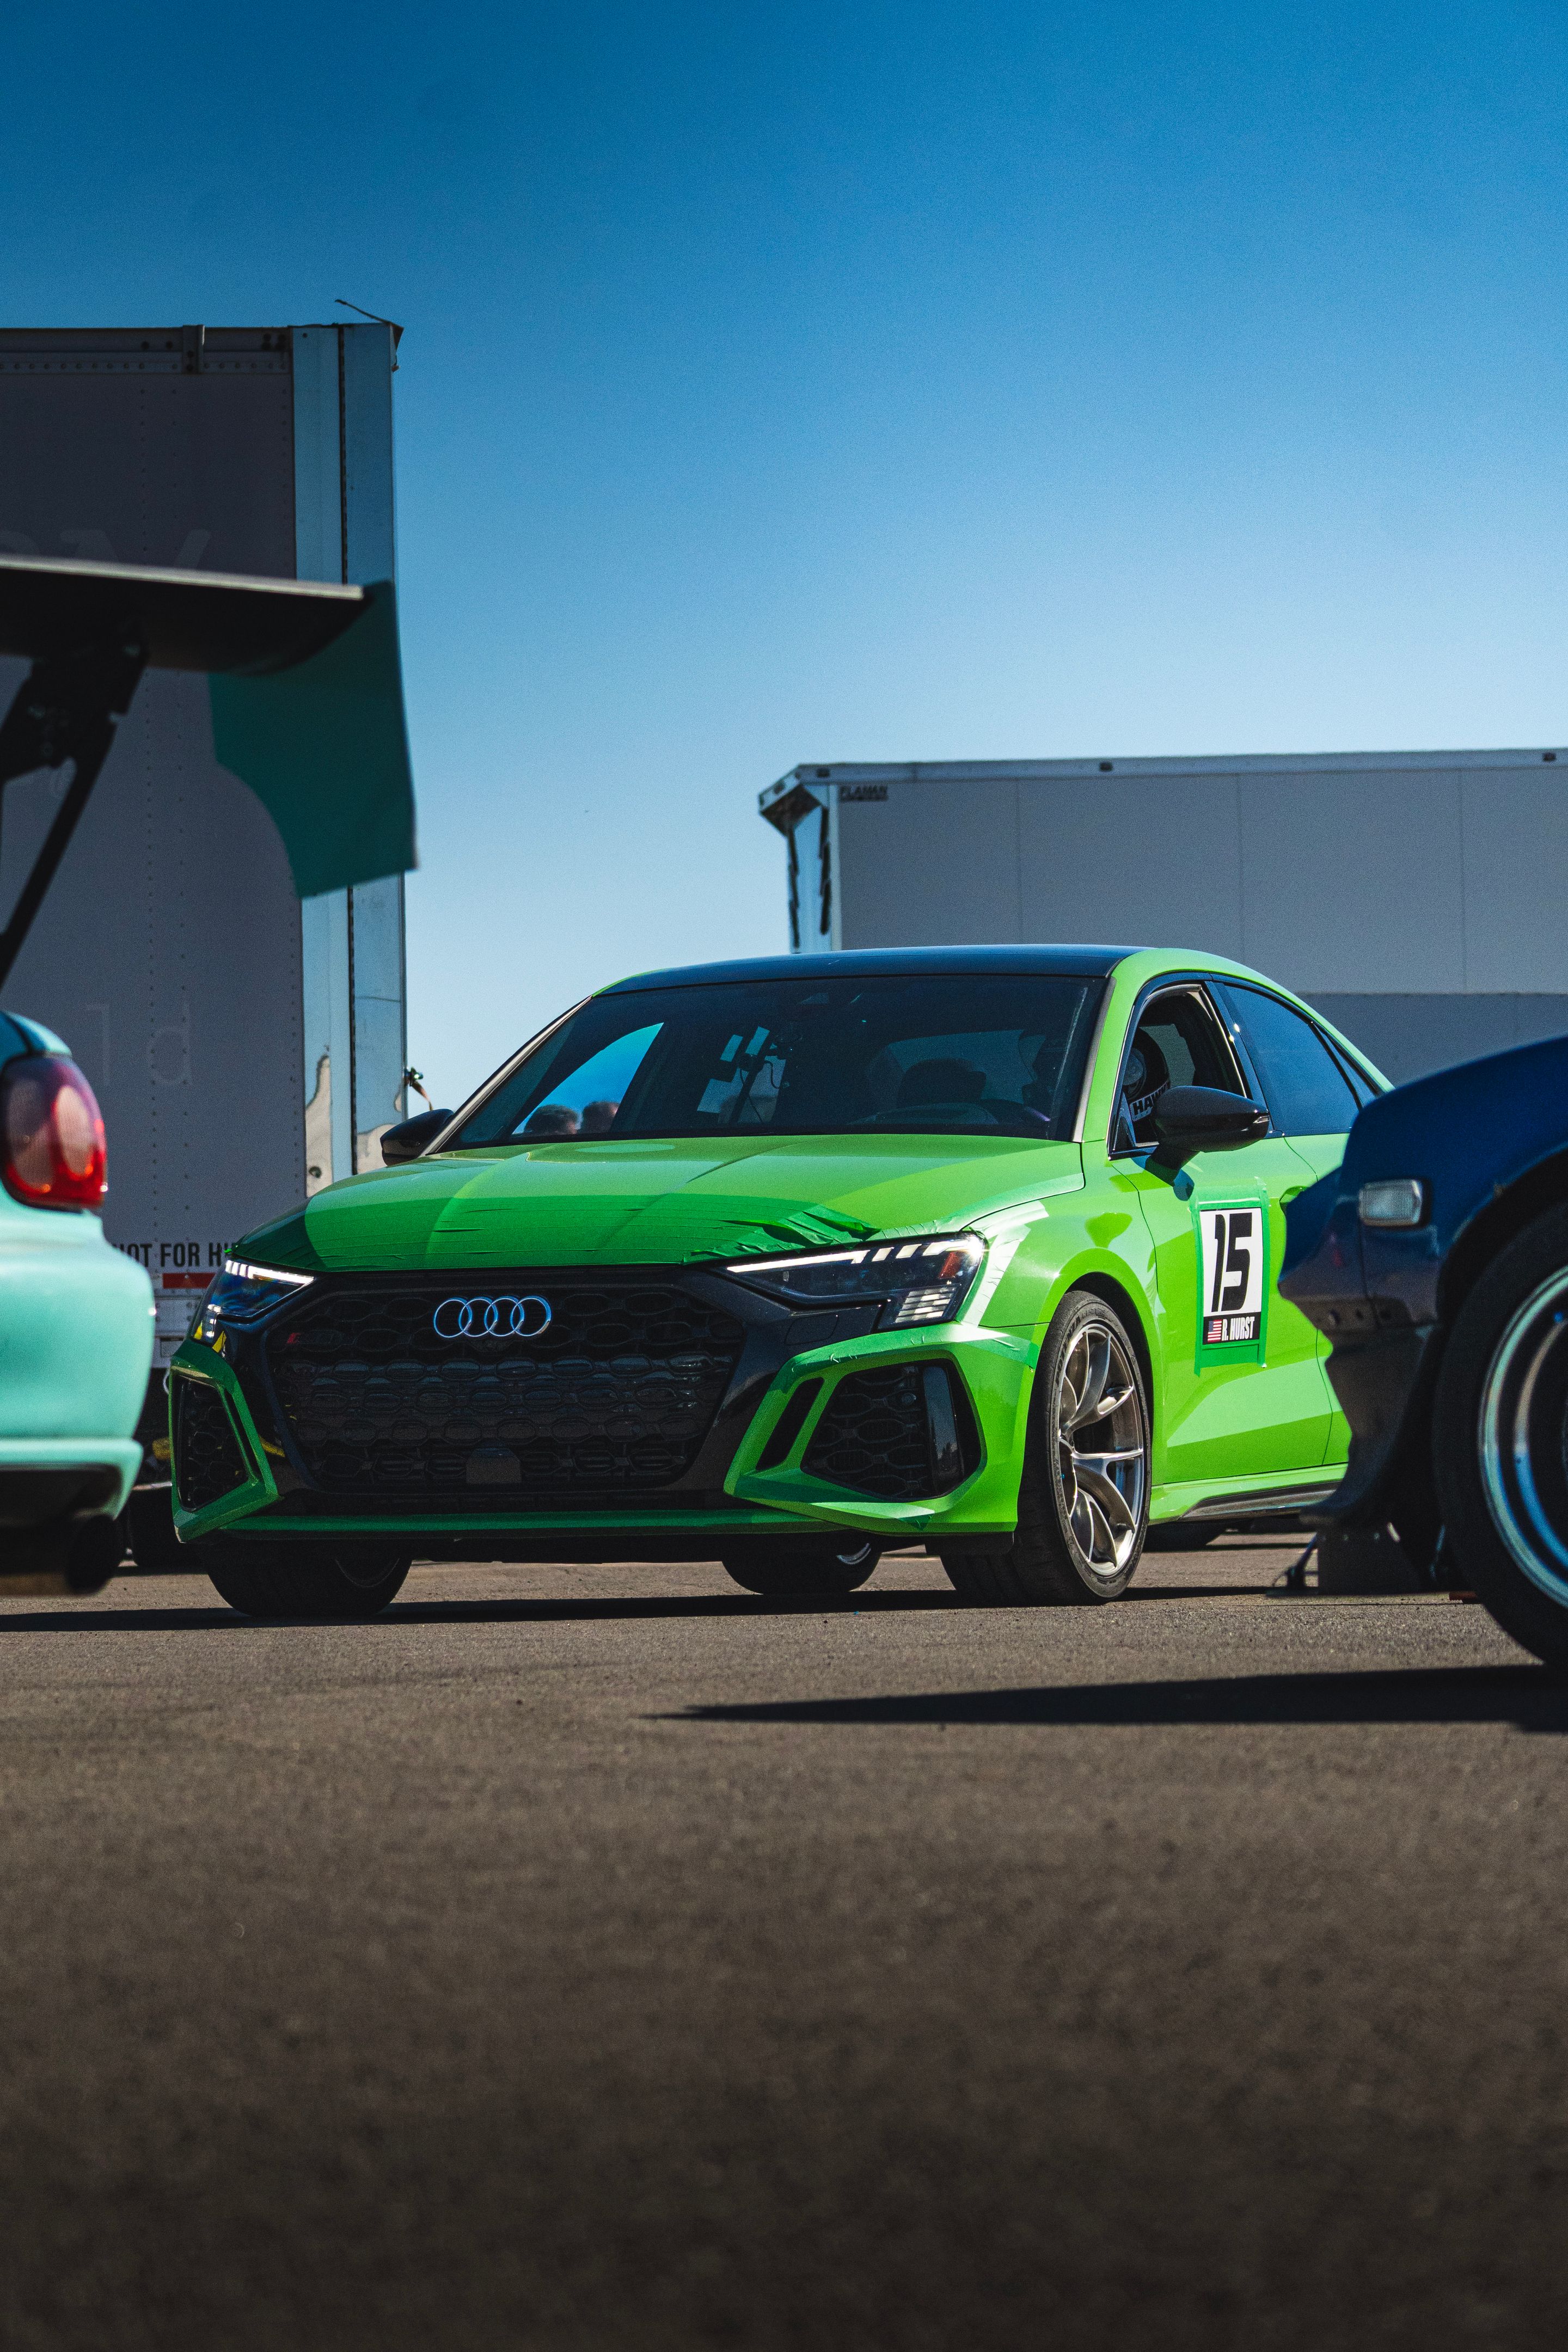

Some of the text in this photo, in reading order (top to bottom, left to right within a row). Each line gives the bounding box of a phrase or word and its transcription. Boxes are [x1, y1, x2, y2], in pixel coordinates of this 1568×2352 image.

[112, 1243, 152, 1267] OT
[161, 1242, 200, 1267] FOR
[1211, 1212, 1252, 1312] 15
[1221, 1316, 1255, 1342] R. HURST
